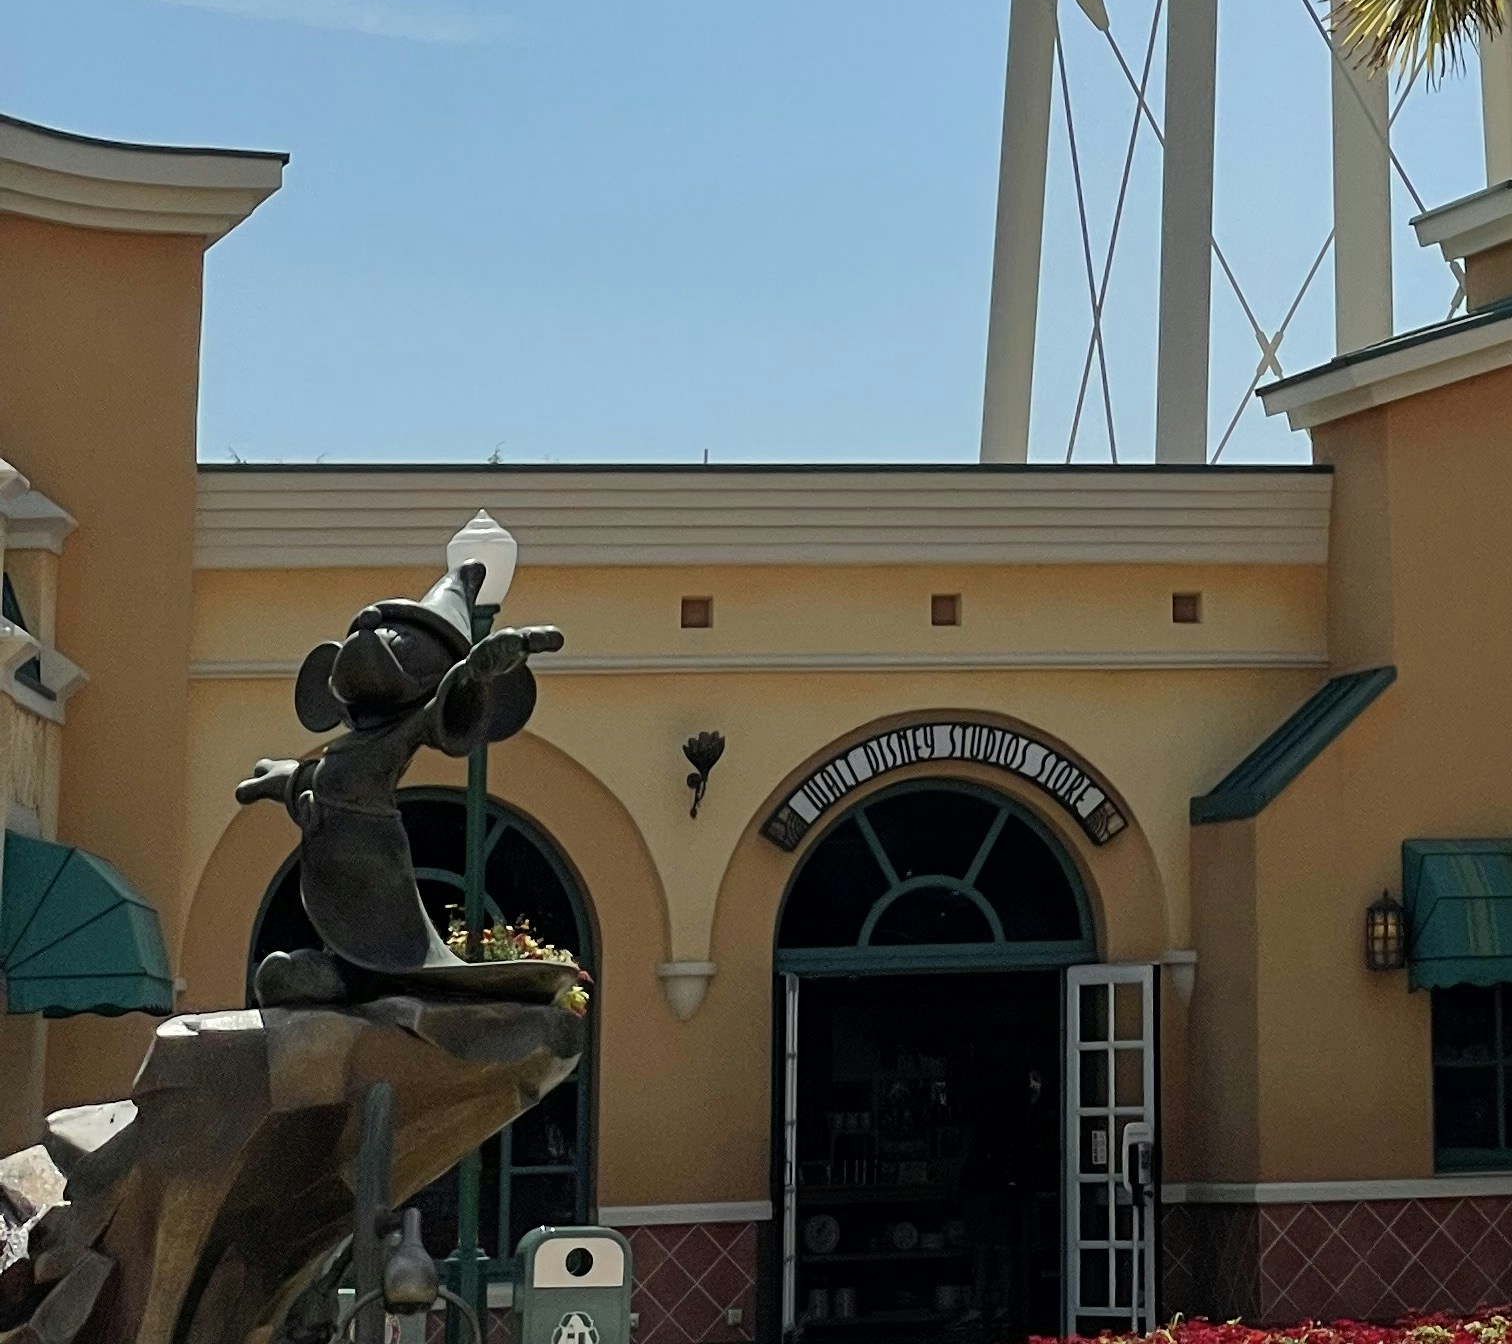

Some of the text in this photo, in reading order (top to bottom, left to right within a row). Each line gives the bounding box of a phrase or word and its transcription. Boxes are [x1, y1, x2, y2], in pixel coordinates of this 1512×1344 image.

[801, 753, 860, 810] WALT
[949, 723, 1030, 771] STUDIOS
[1036, 752, 1093, 810] STORE
